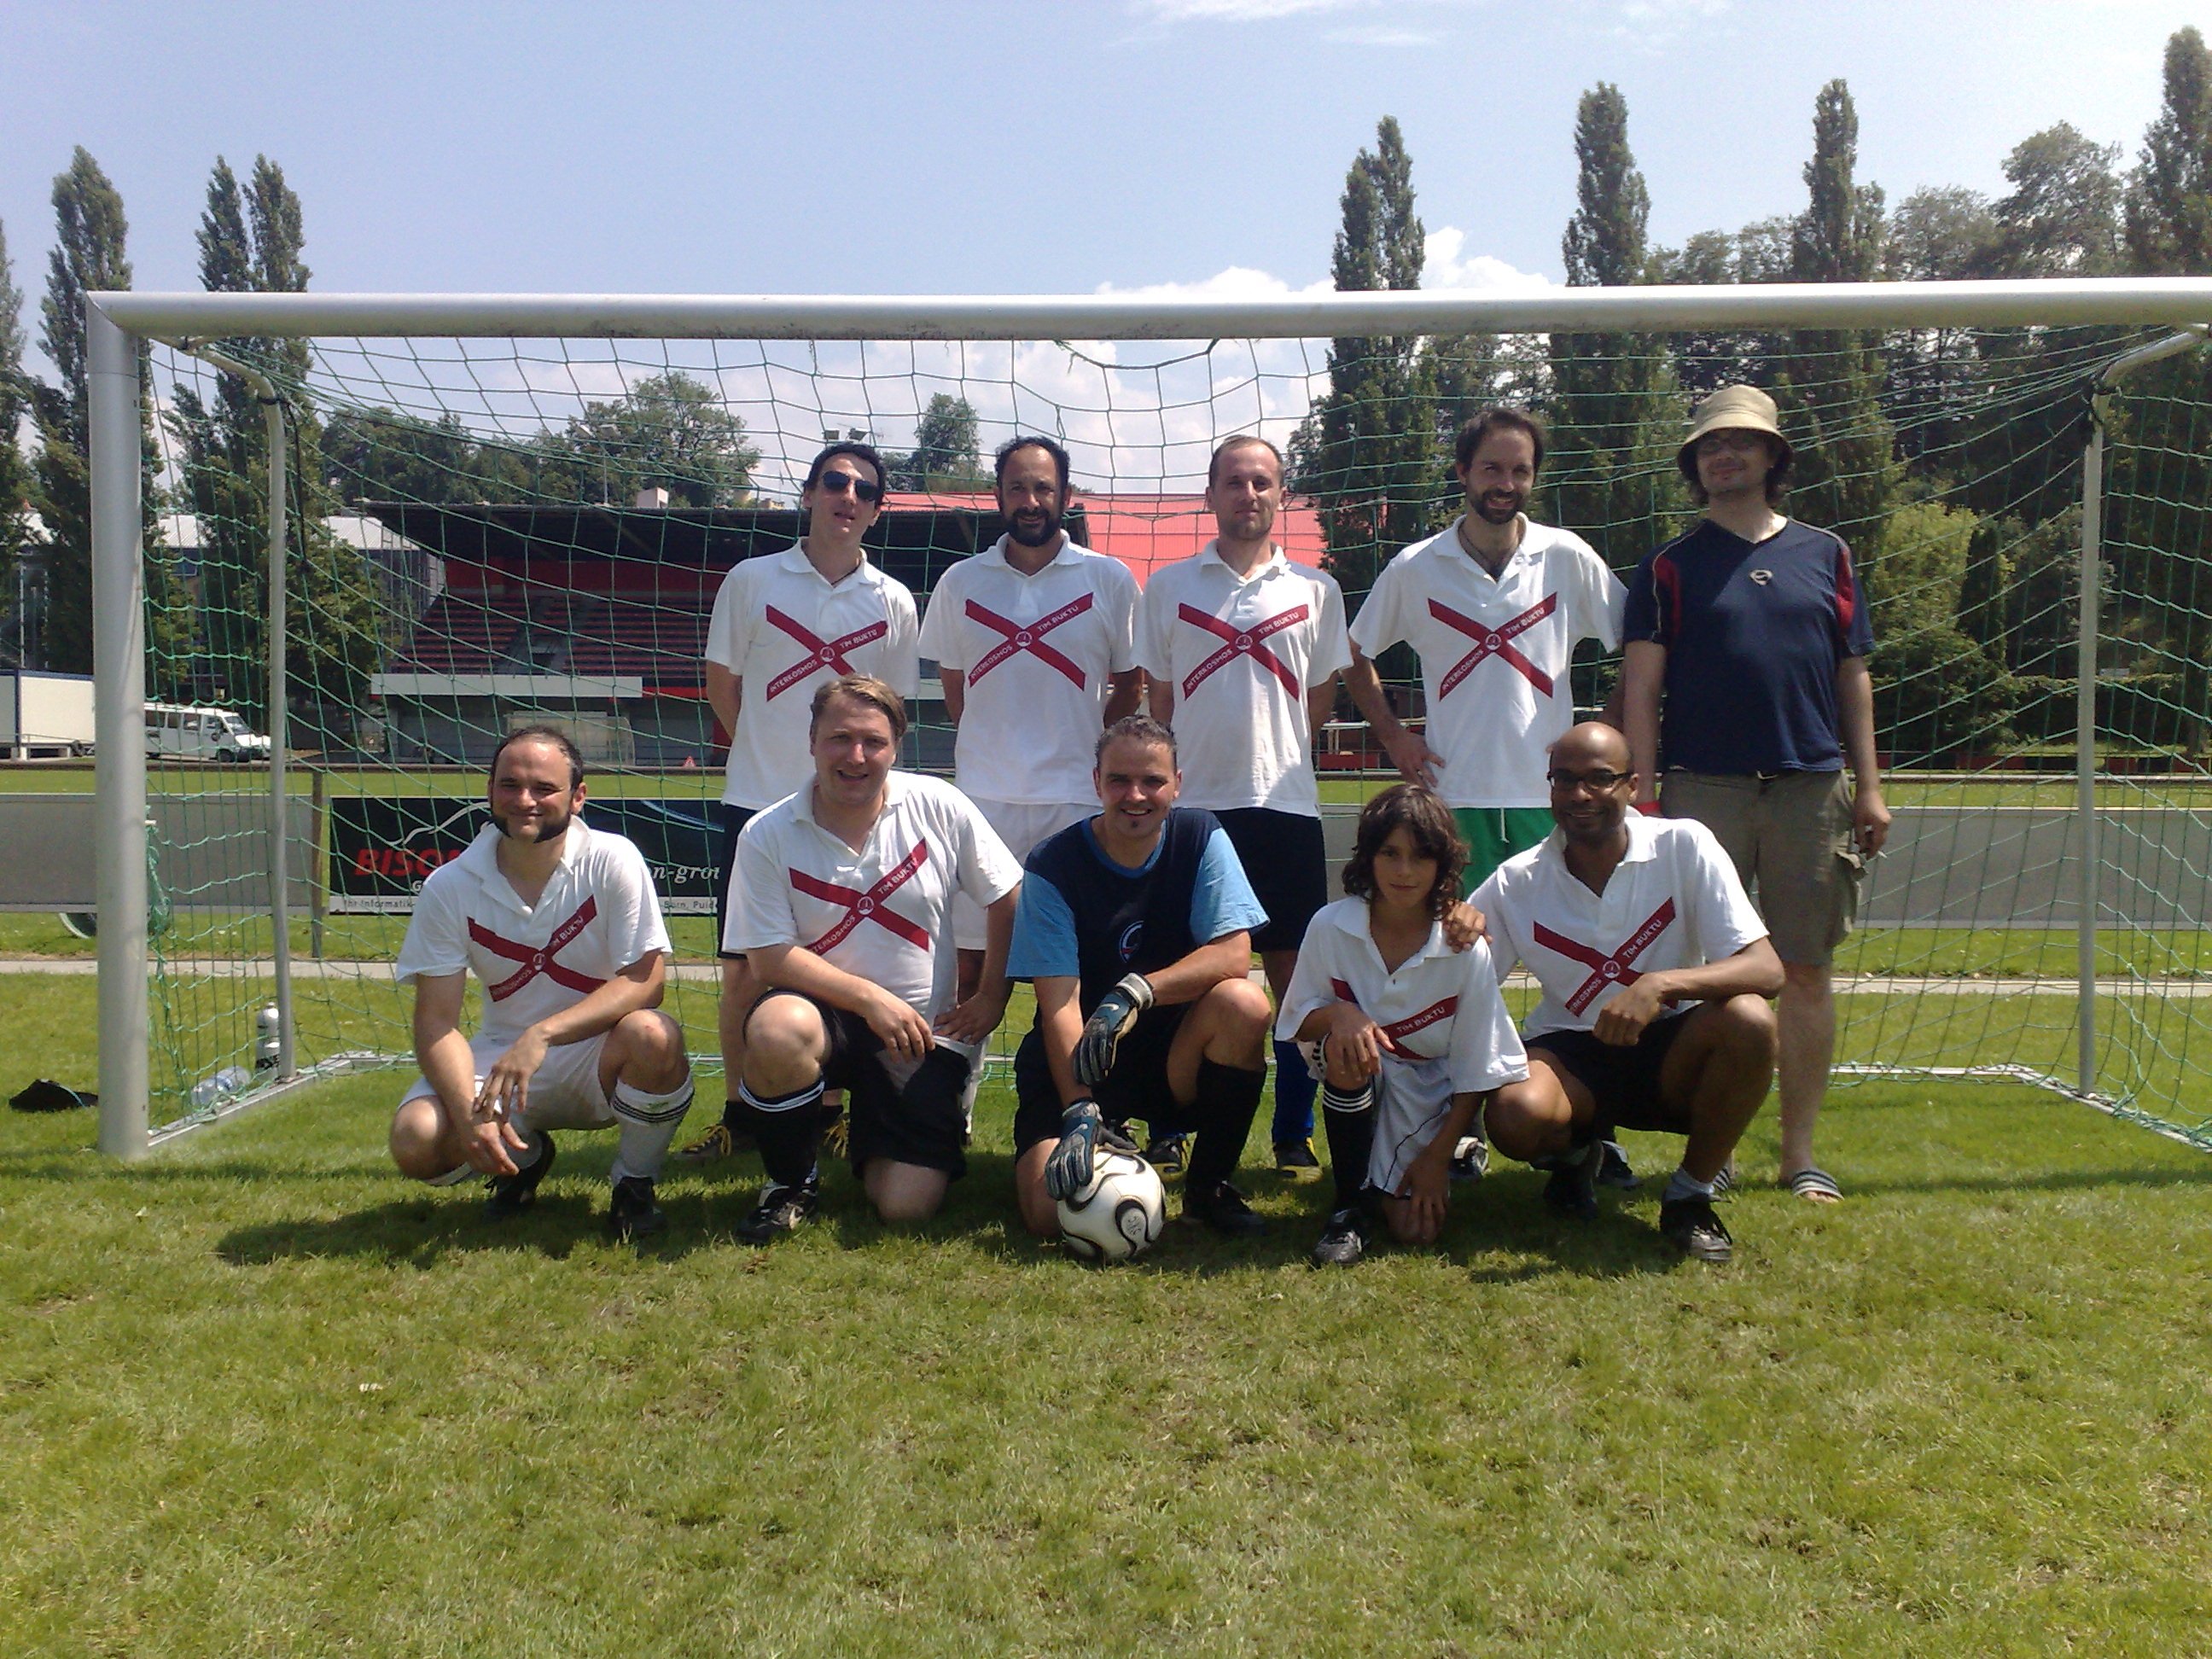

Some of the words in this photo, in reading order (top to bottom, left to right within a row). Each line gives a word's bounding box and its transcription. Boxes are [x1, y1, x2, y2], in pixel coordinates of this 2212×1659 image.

[1037, 621, 1051, 632] TIM
[1187, 649, 1233, 690] INTERKOSMOS
[1258, 624, 1272, 635] TIM
[1274, 611, 1301, 629] BUKTU
[877, 882, 892, 895] TIM
[1622, 945, 1638, 958] TIM
[1637, 919, 1662, 946] BUKTU
